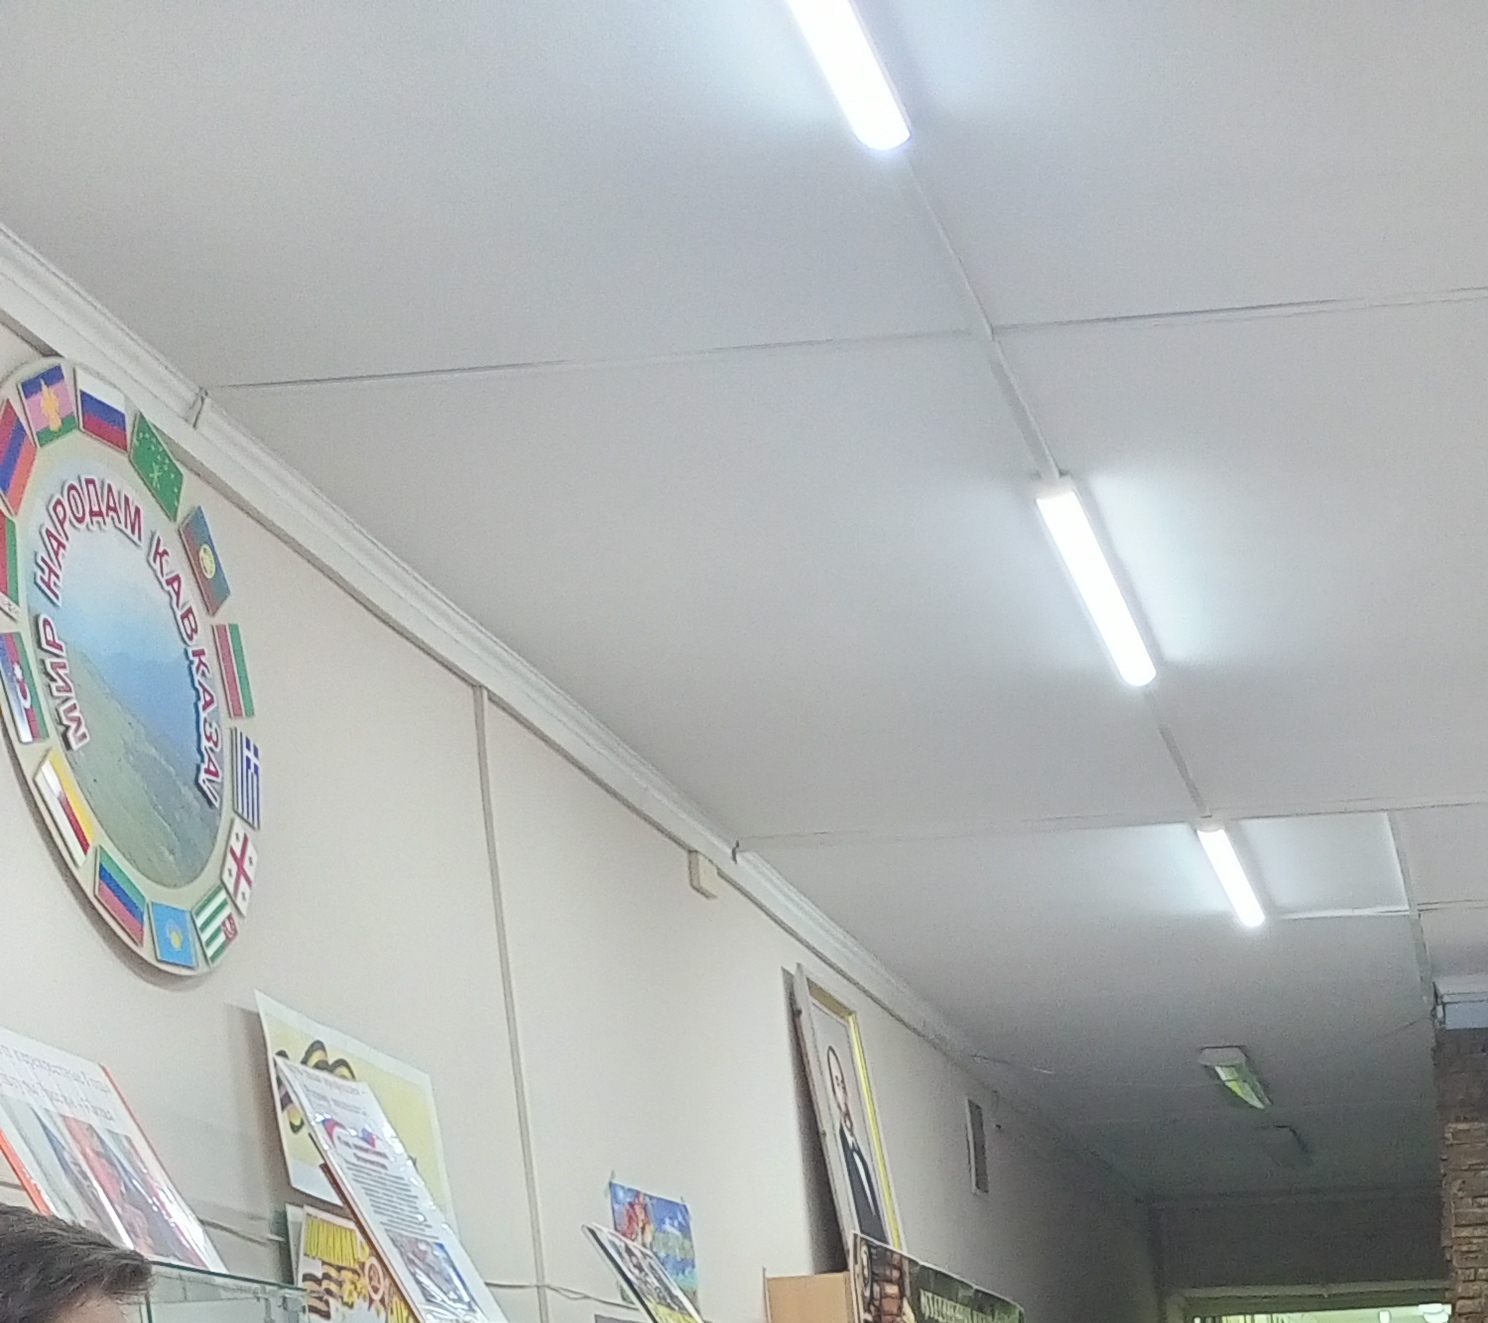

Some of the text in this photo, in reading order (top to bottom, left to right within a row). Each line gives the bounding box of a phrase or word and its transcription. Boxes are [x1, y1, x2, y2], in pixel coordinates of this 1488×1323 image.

[37, 477, 222, 807] МИР НАРОДАМ КАВКАЗА!
